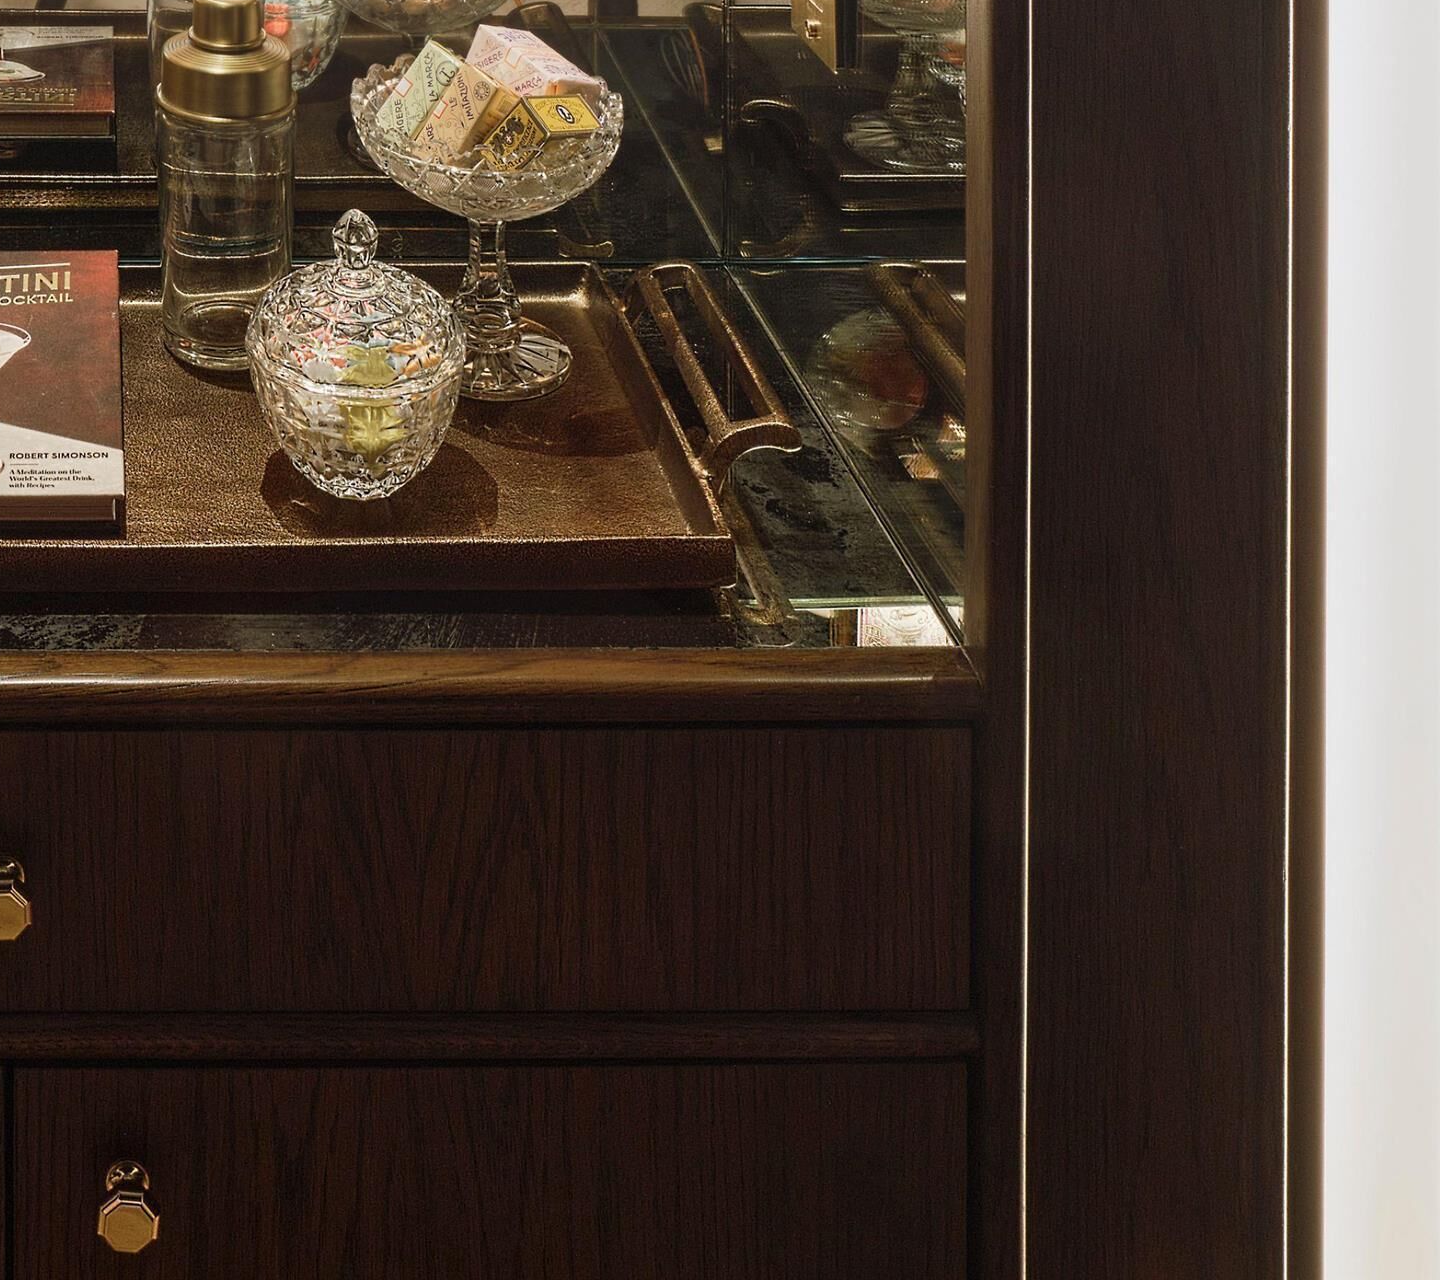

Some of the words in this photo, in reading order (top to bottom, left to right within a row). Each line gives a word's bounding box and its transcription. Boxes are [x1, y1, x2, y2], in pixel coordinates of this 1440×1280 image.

[424, 51, 436, 91] MARCA
[514, 76, 542, 93] MARCA
[429, 91, 439, 103] LA
[9, 452, 49, 460] ROBERT
